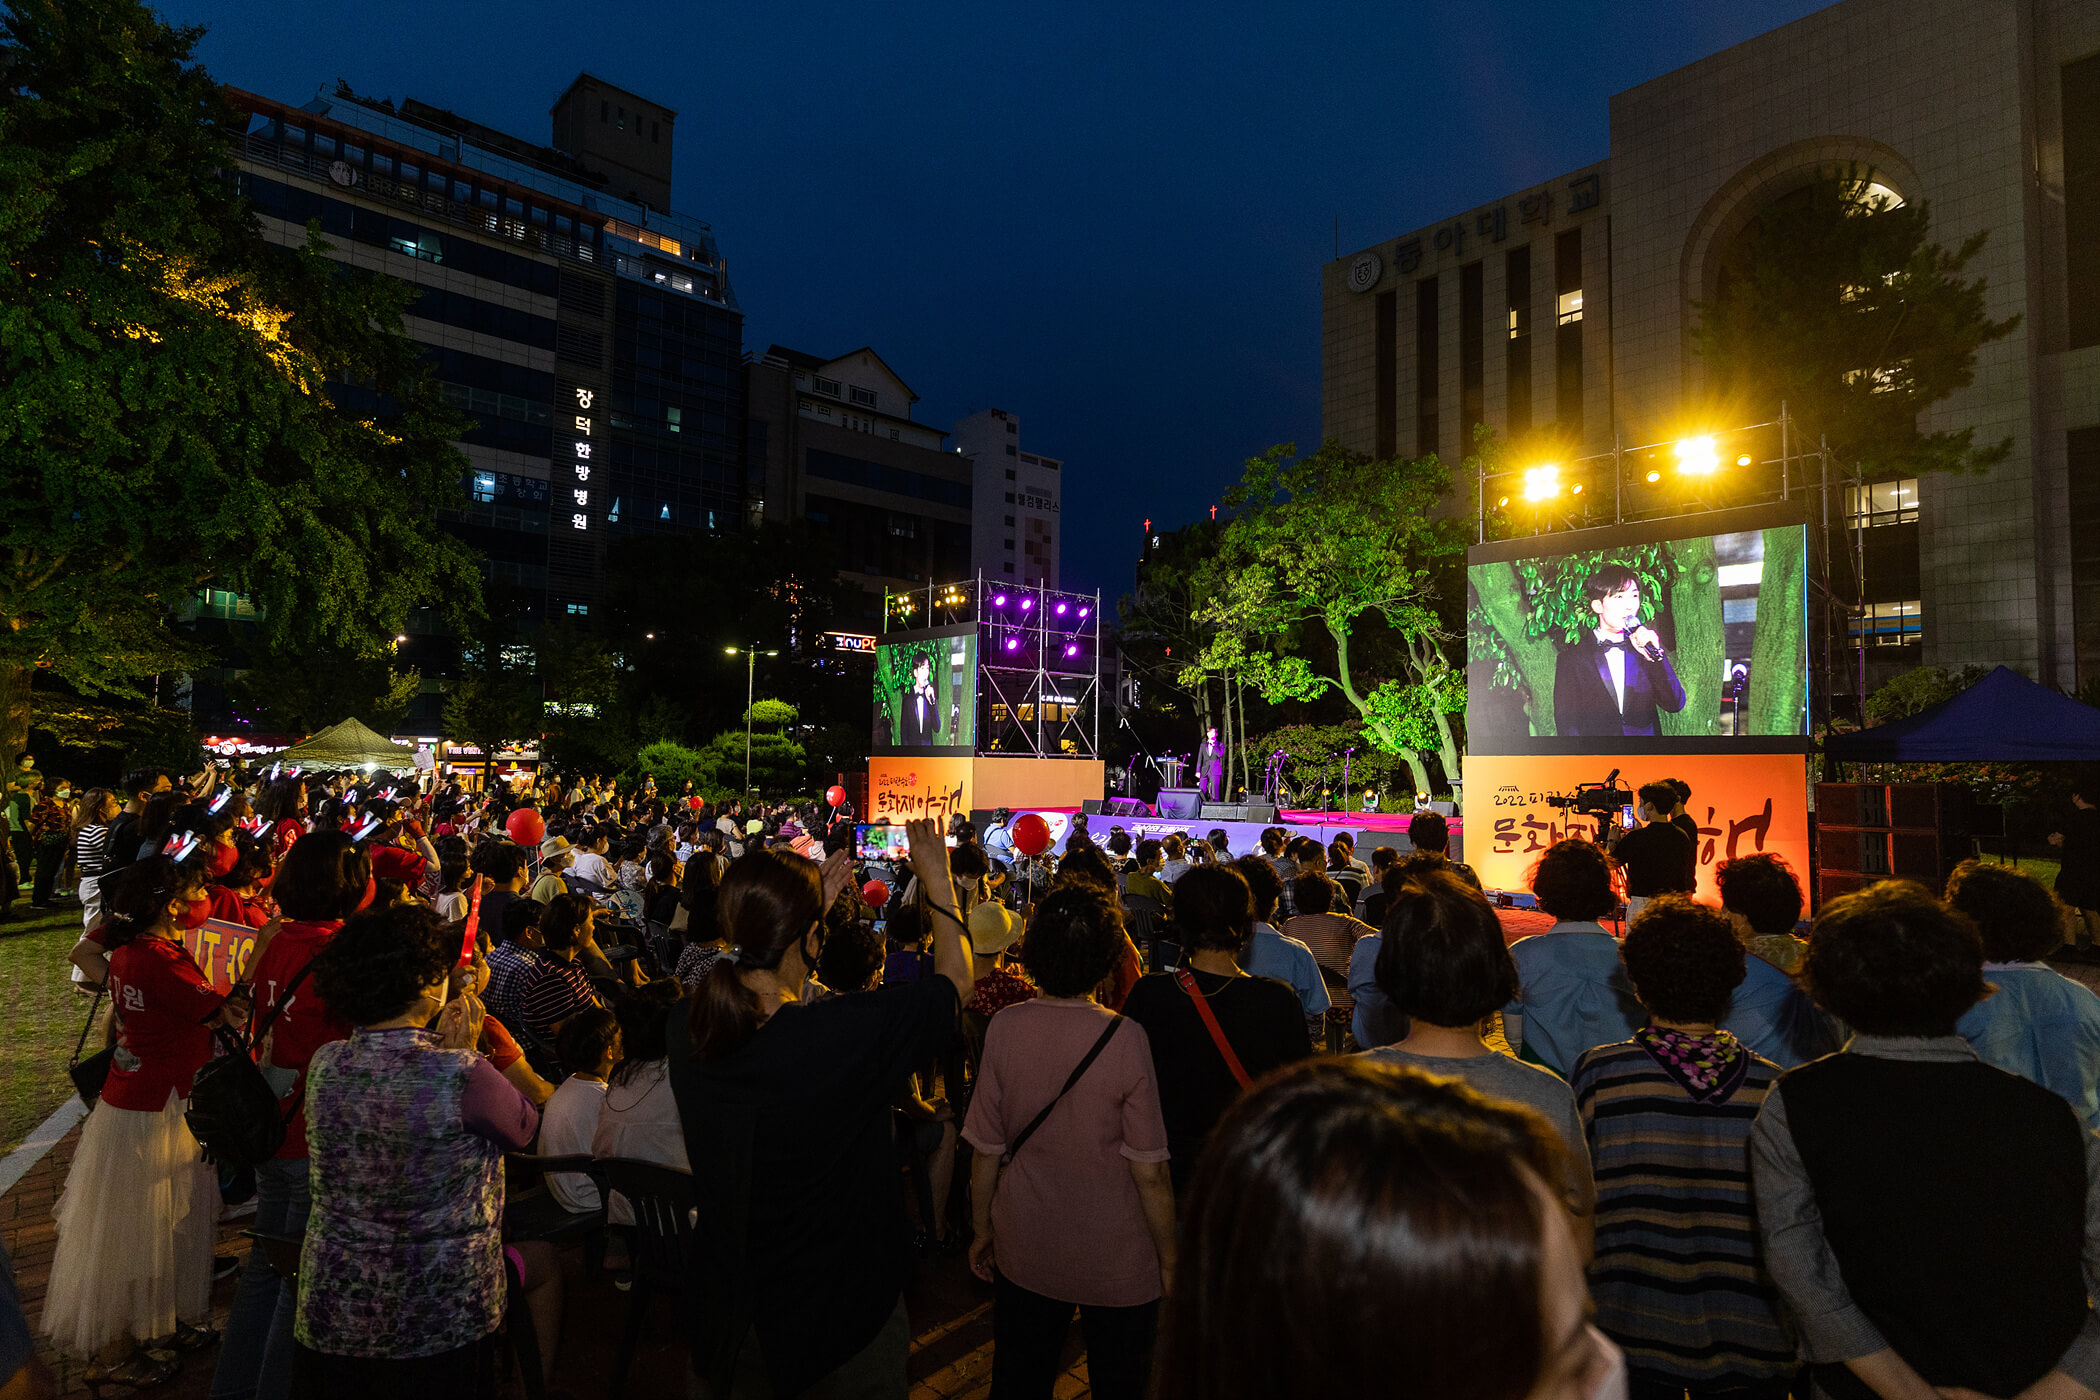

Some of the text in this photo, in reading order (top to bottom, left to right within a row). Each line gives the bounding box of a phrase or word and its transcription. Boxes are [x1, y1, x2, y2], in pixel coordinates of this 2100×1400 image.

[1394, 174, 1599, 273] 동아대학교
[571, 388, 594, 531] 장덕한방병원
[1493, 795, 1527, 806] 2022
